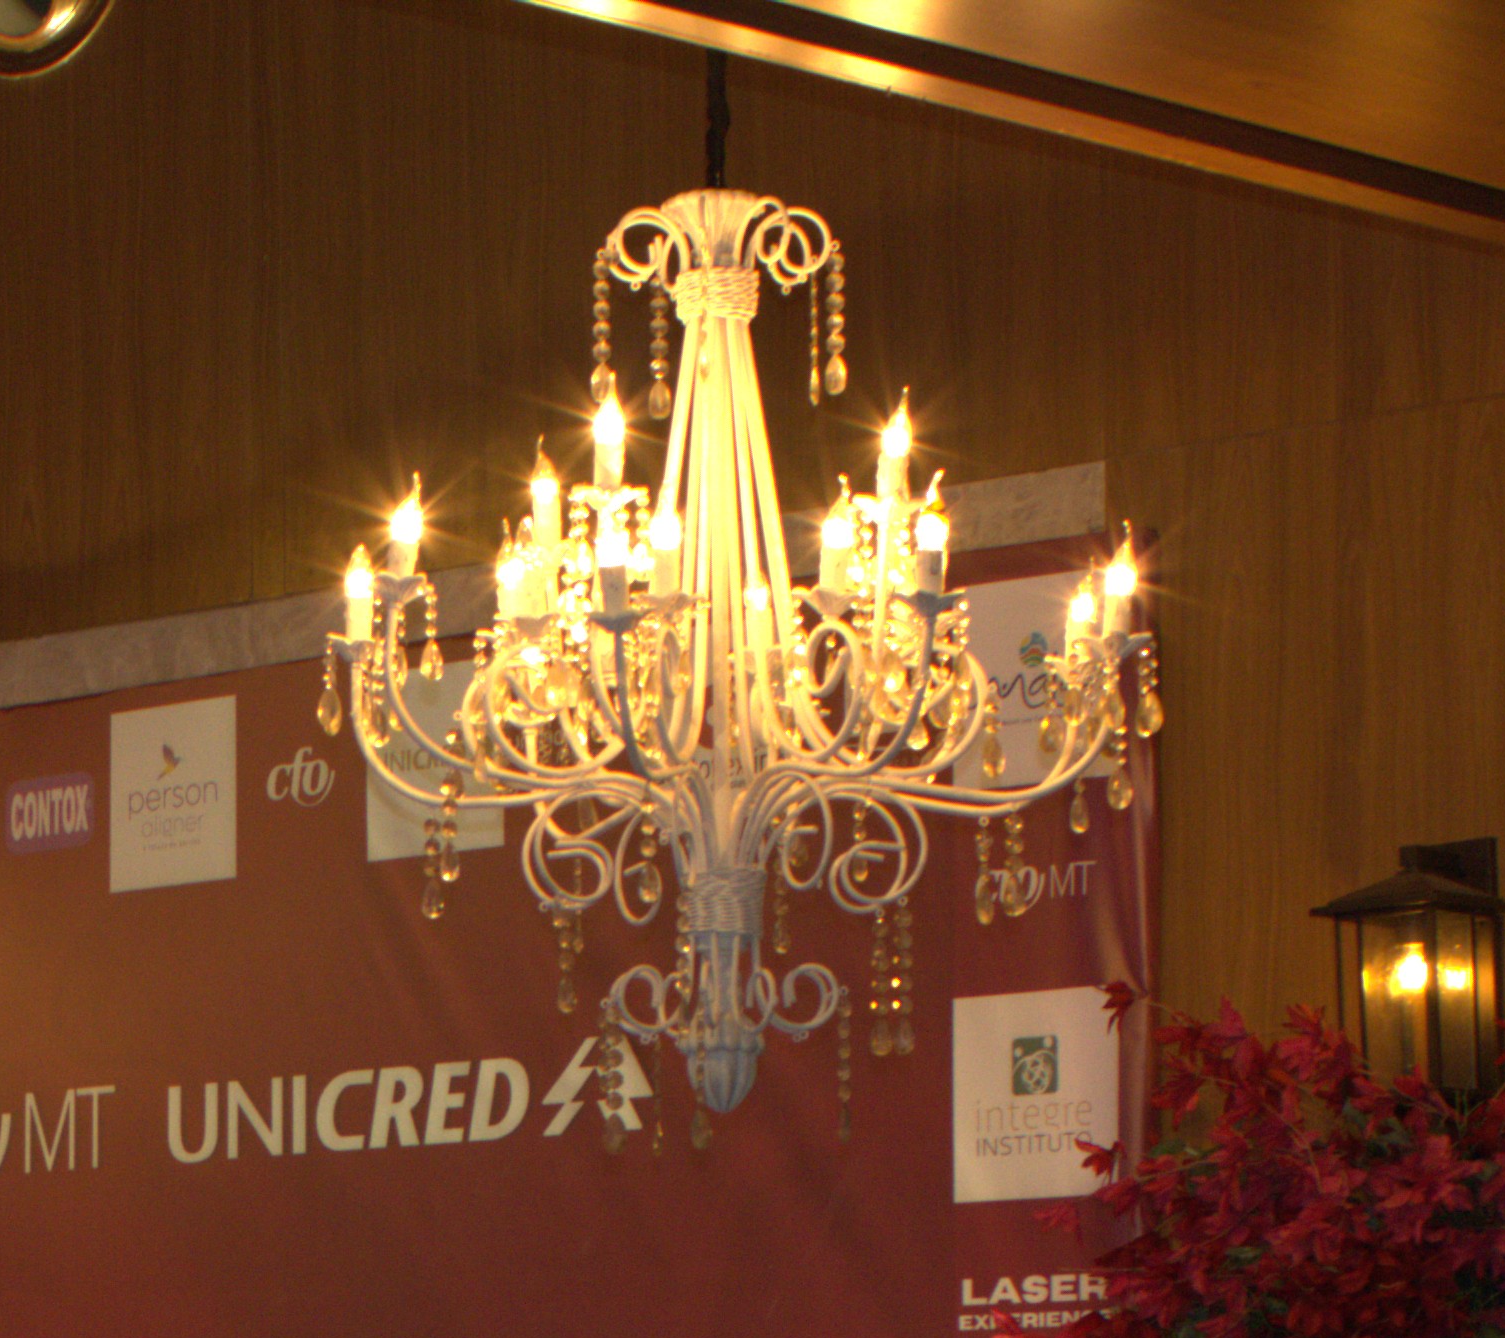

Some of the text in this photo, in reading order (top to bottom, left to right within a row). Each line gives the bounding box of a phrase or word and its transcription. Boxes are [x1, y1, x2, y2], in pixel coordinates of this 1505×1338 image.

[10, 784, 89, 841] CONTOX
[128, 780, 219, 820] person
[25, 1084, 116, 1174] MT
[167, 1057, 530, 1163] UNICRED
[976, 1099, 1093, 1133] integre
[962, 1273, 1109, 1306] LASER
